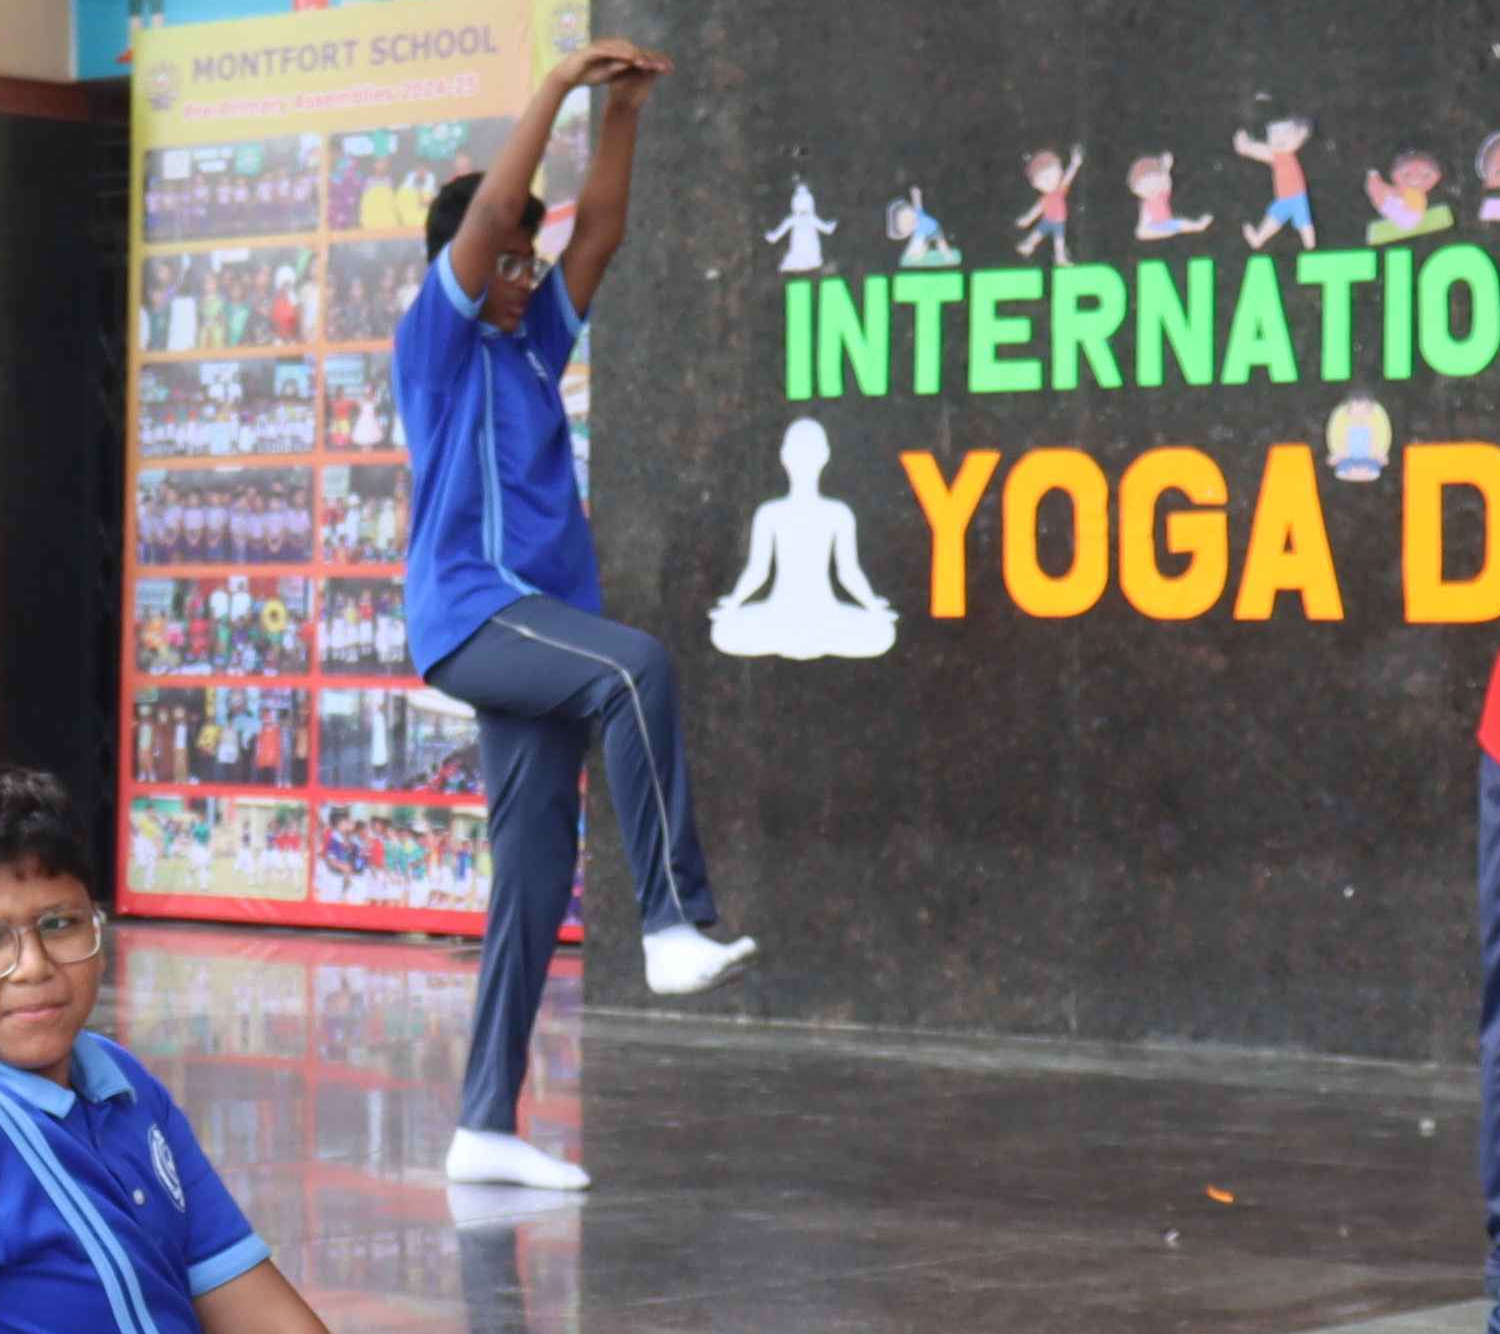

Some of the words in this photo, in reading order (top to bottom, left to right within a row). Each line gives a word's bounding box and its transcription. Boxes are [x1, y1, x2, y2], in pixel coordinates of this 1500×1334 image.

[191, 39, 360, 84] MONTFORT
[369, 24, 498, 66] SCHOOL
[901, 443, 1343, 623] YOGA
